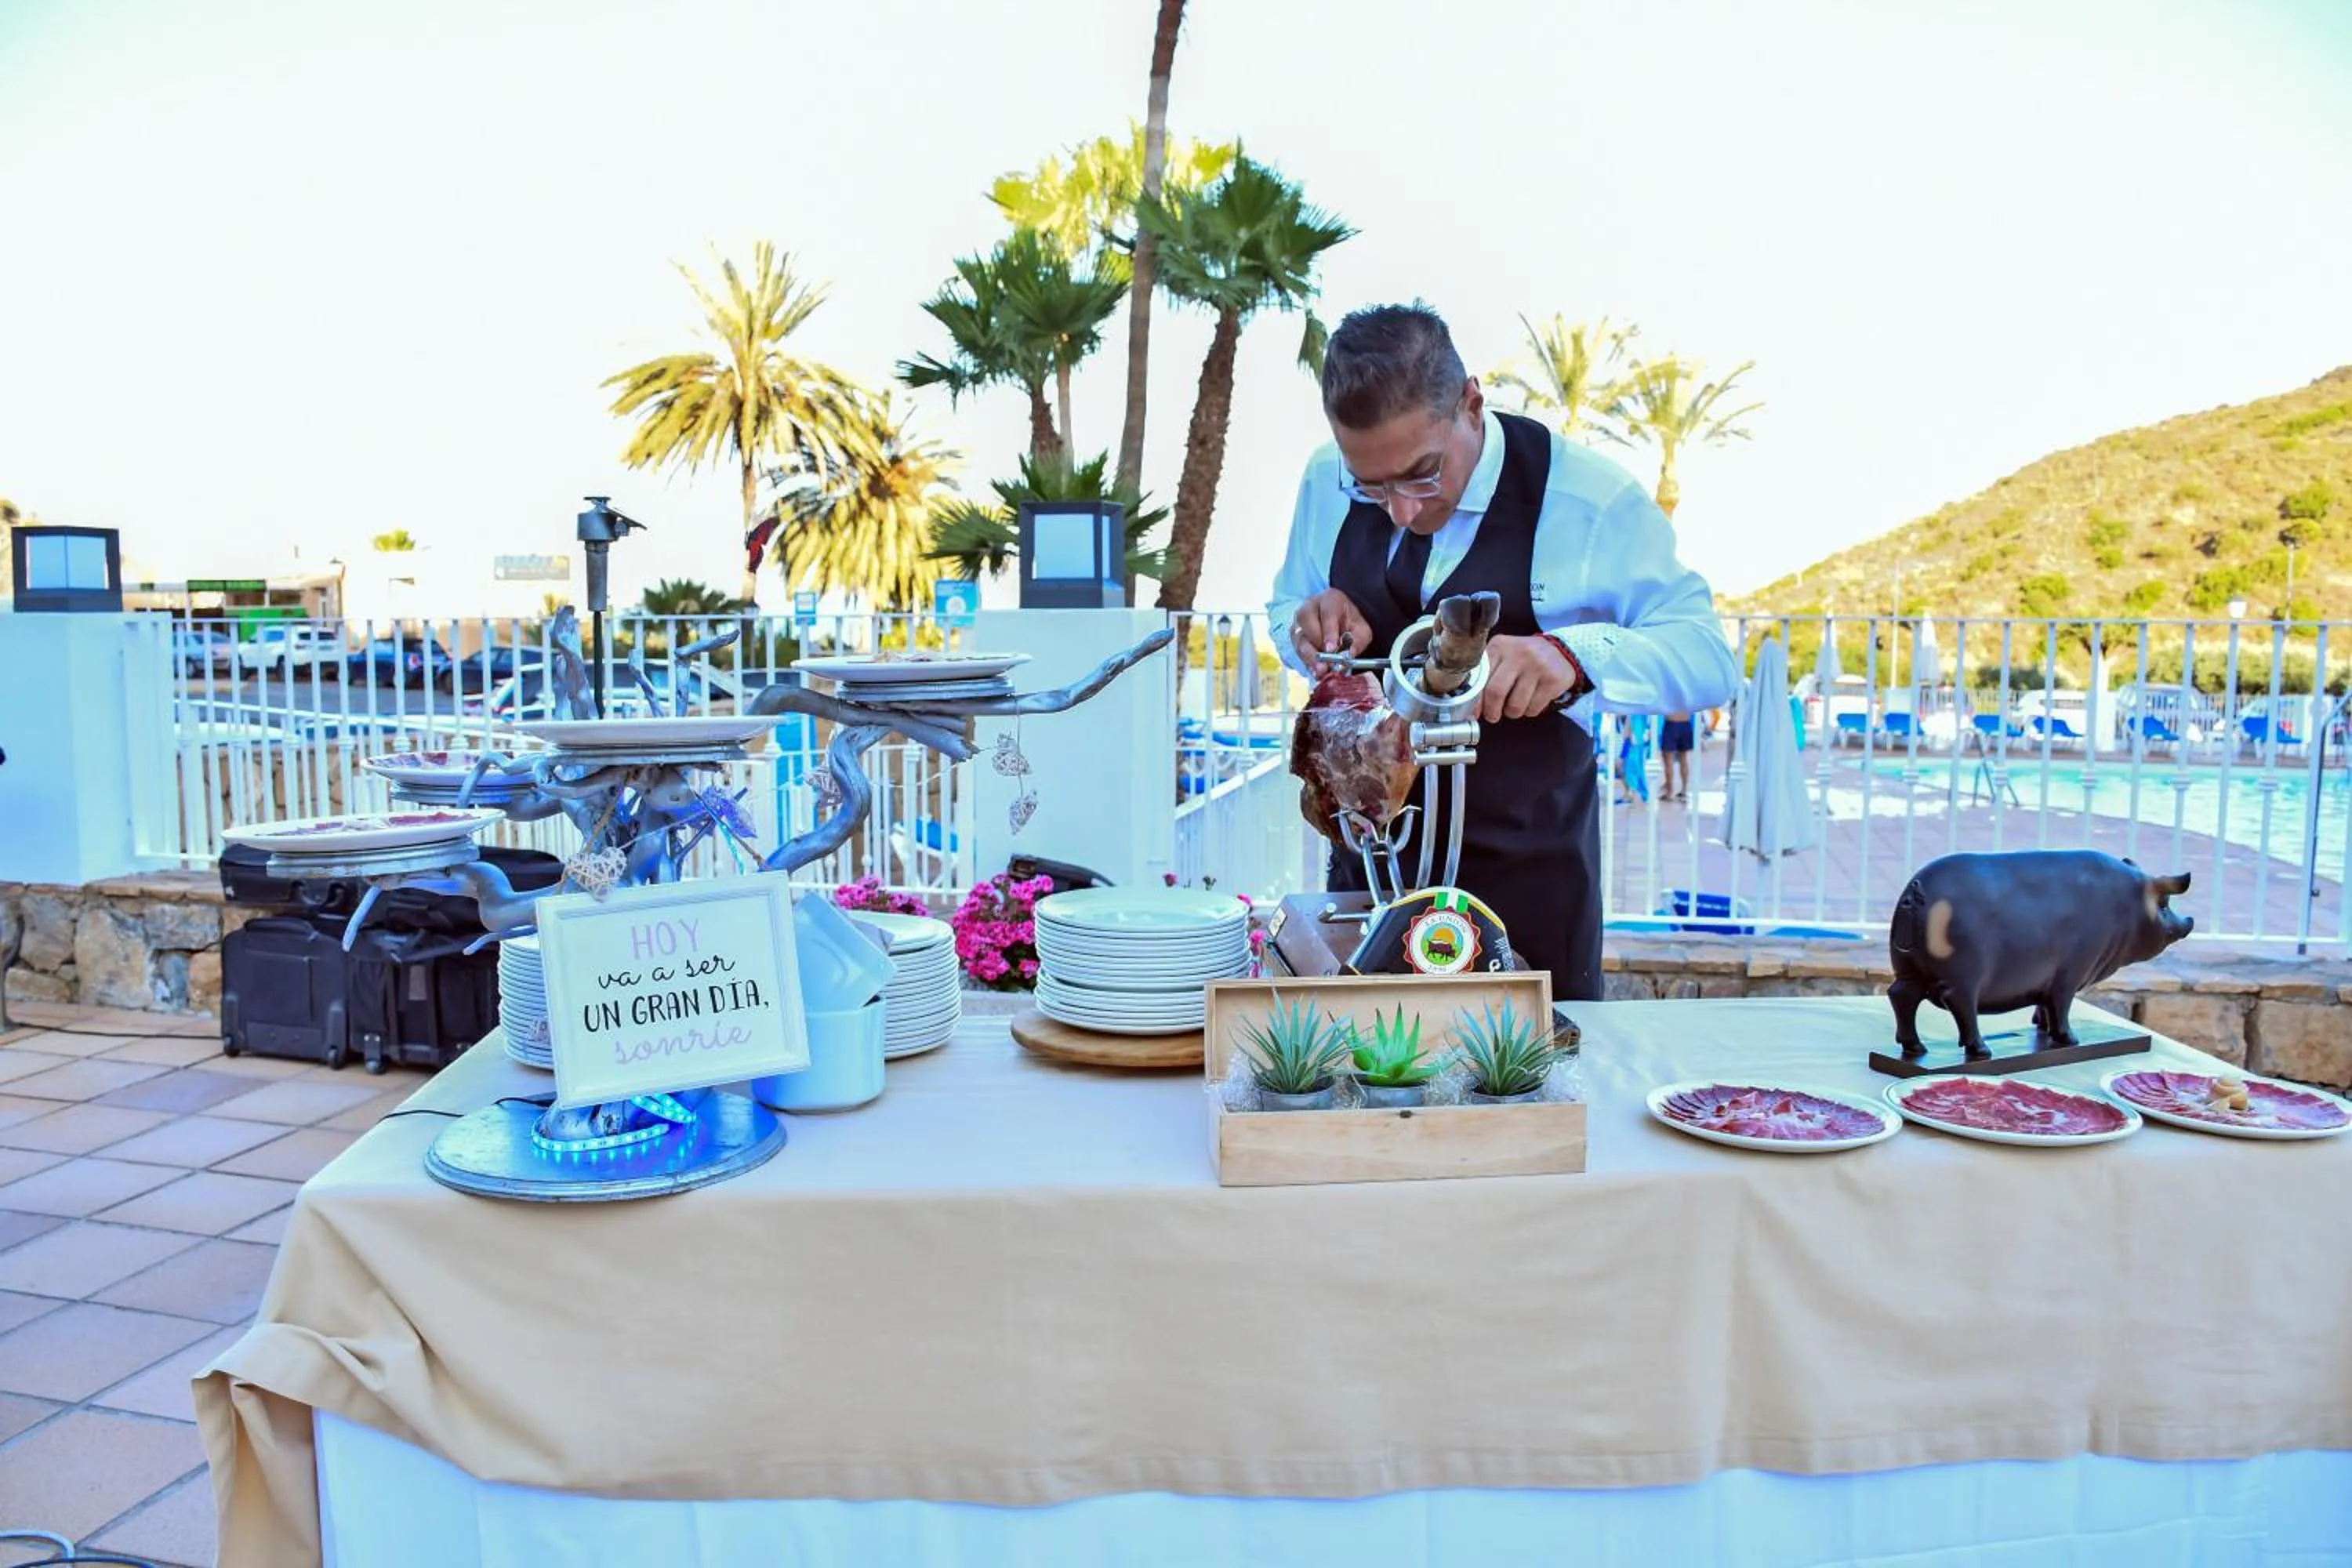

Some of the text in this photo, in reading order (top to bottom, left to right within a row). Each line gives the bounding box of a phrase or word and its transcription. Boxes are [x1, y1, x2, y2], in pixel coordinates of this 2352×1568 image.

[631, 918, 699, 960] HOY
[598, 955, 735, 989] va a ser
[584, 977, 769, 1032] UN GRAN DÍA,
